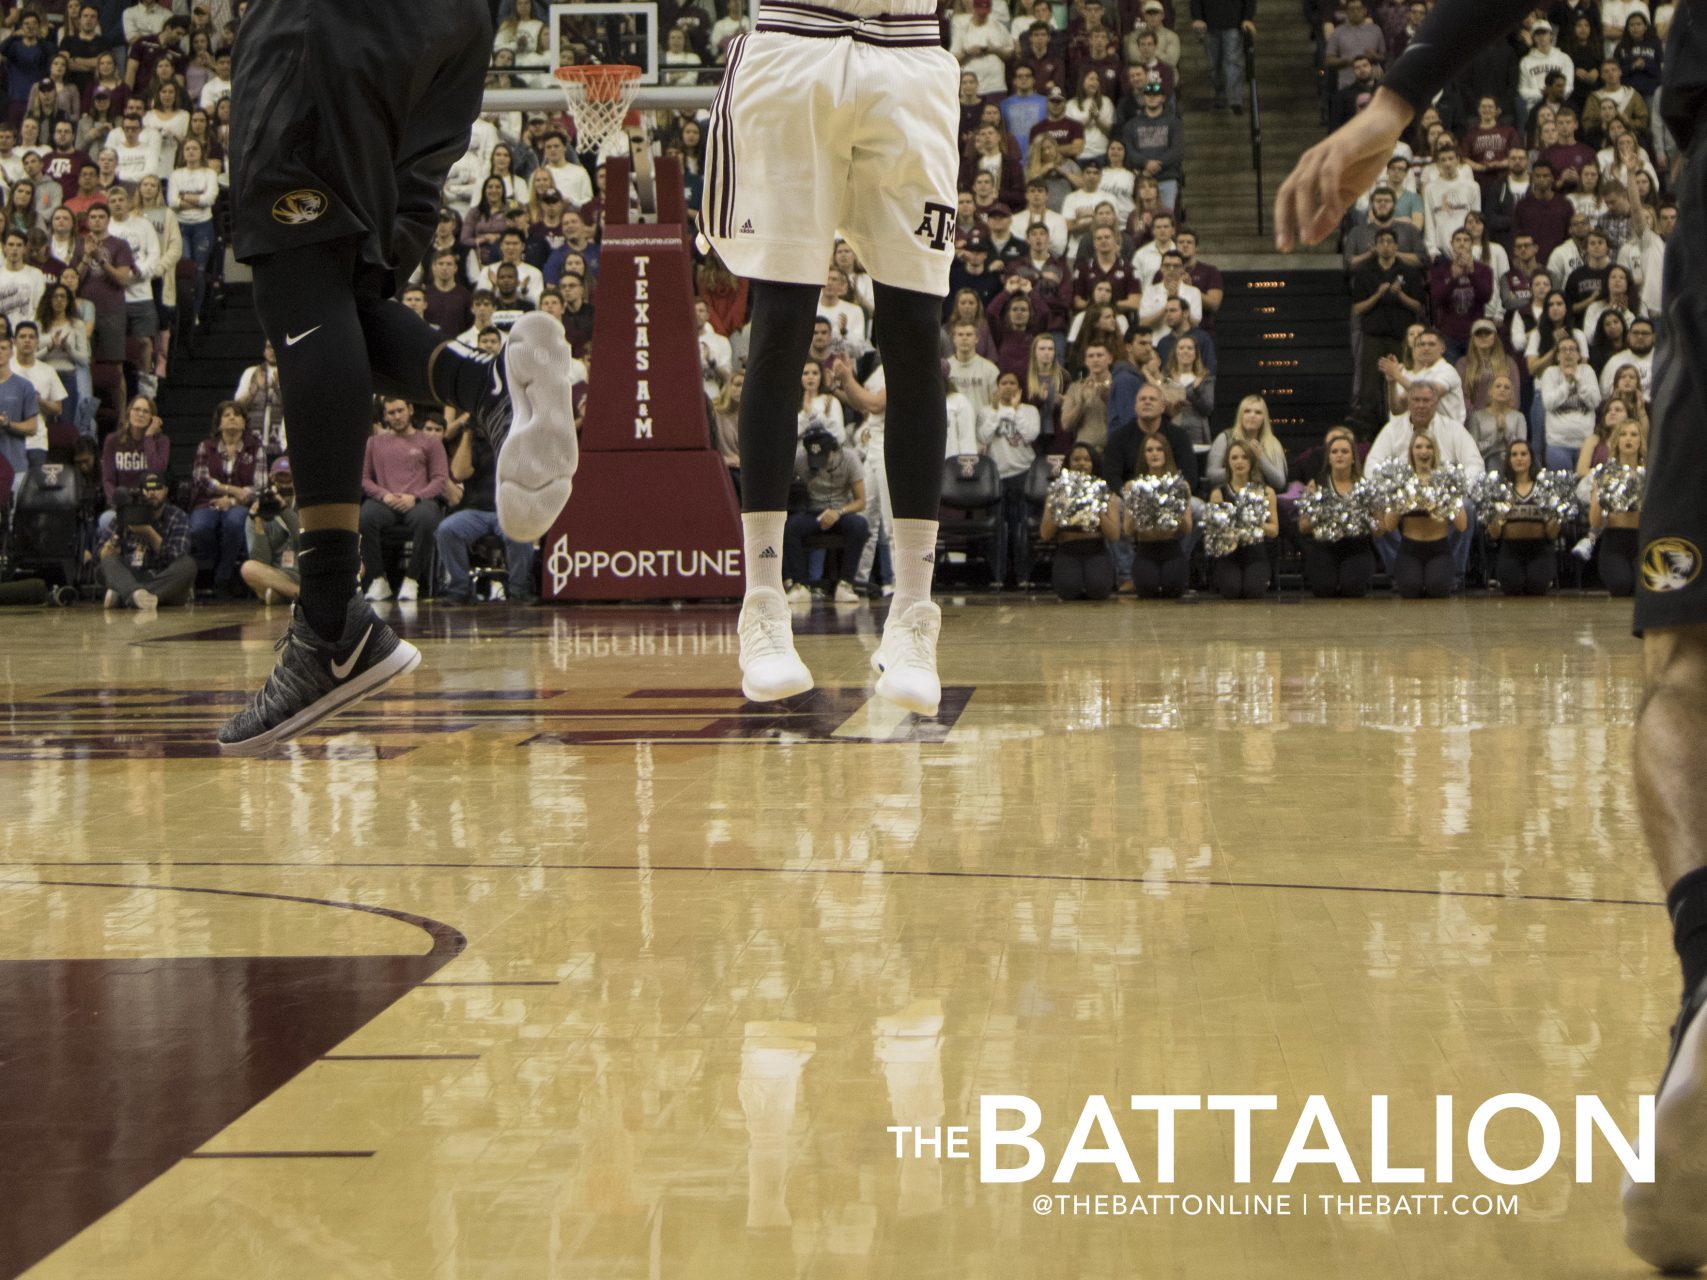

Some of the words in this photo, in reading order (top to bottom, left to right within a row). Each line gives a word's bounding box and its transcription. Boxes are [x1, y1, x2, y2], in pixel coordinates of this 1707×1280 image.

[602, 236, 682, 247] www.opportune.com
[633, 256, 651, 371] TEXAS
[635, 380, 653, 440] A&M
[115, 450, 147, 470] AGGI
[548, 533, 742, 596] OPPORTUNE
